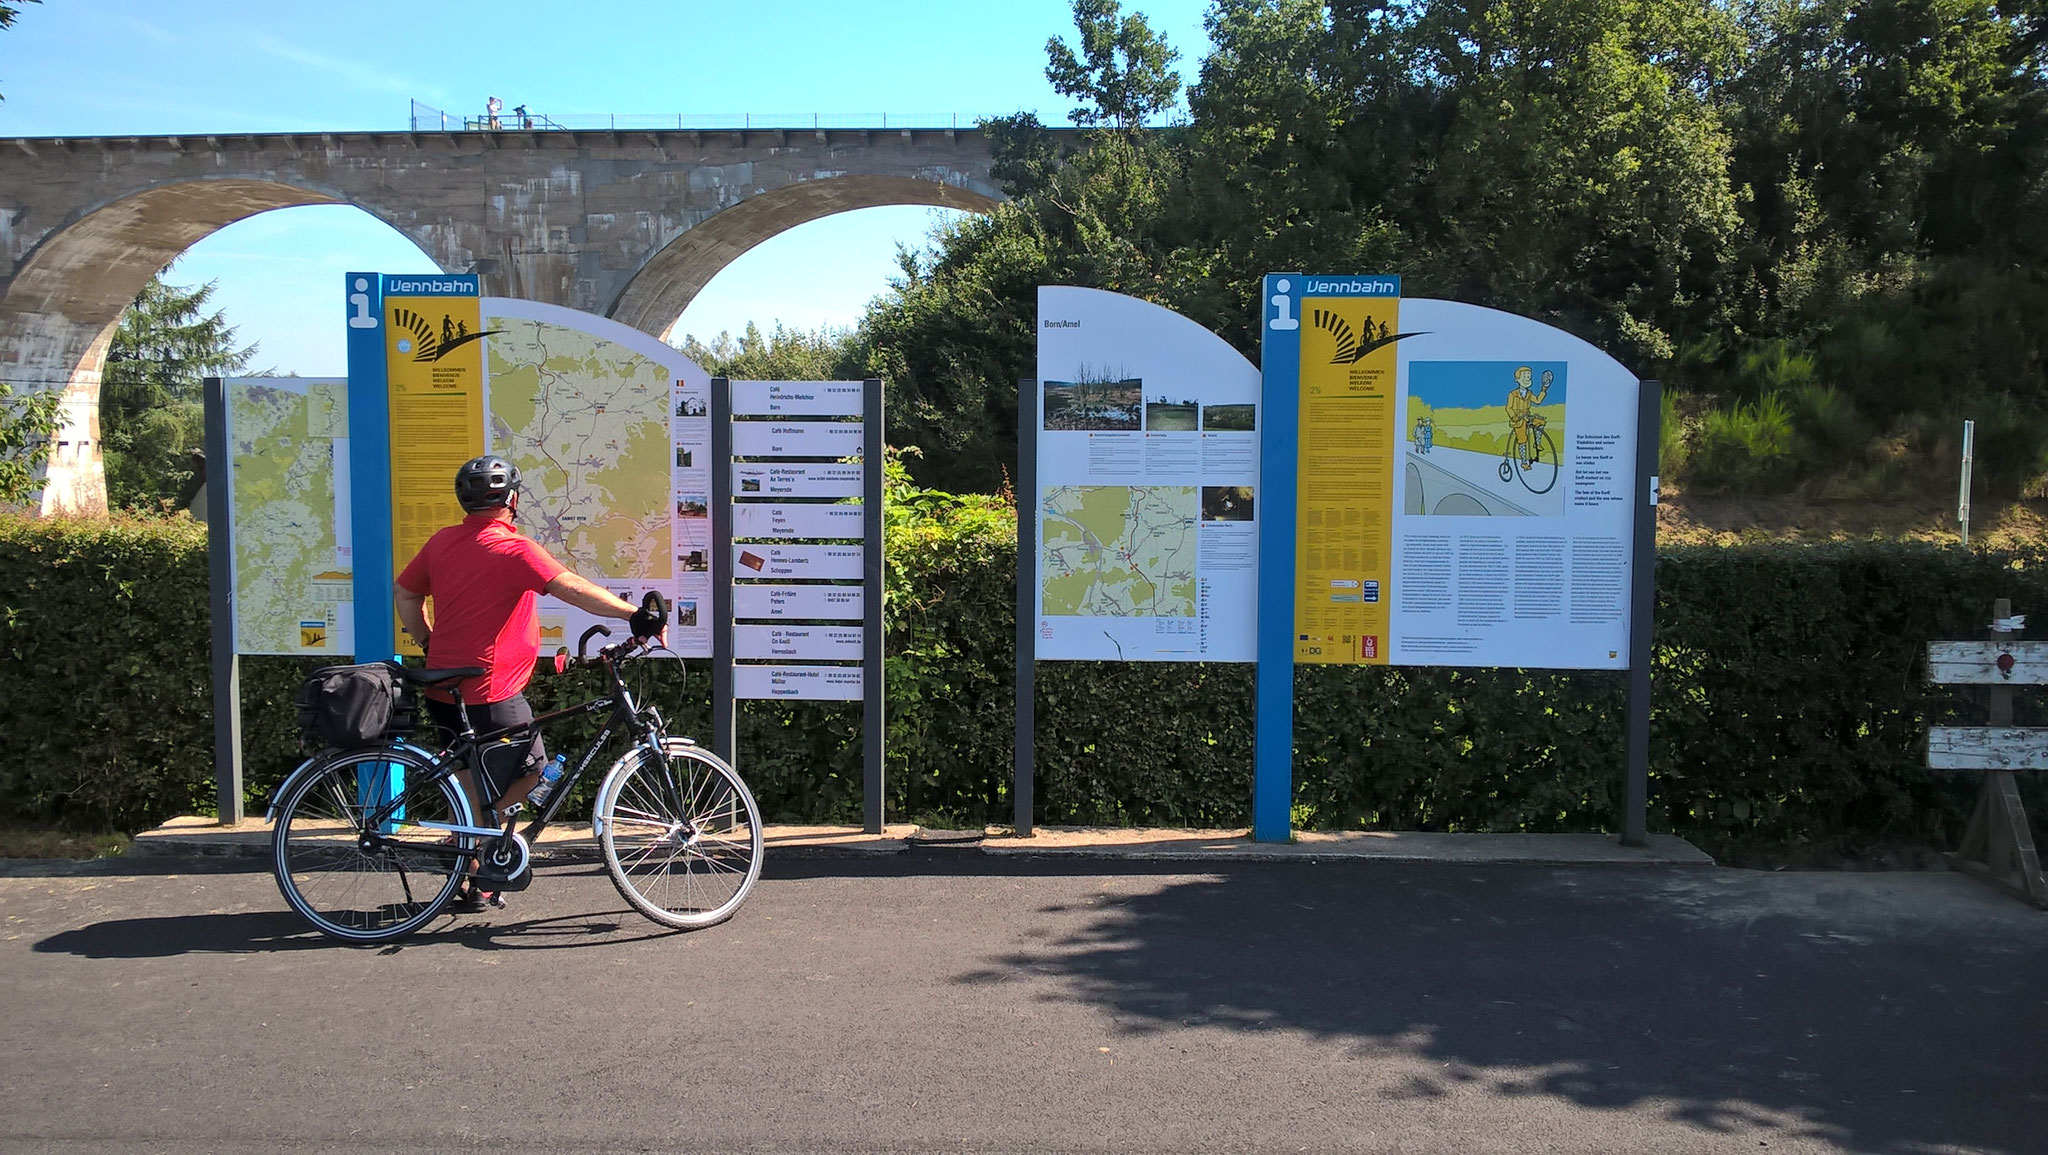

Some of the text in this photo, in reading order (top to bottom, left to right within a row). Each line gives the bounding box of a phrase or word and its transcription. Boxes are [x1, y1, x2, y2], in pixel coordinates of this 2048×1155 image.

[390, 280, 474, 292] Vennbahn
[1307, 280, 1394, 293] Vennbahn
[1044, 320, 1080, 328] Born/Amel
[1309, 646, 1322, 654] DG
[579, 729, 611, 771] HERCULES
